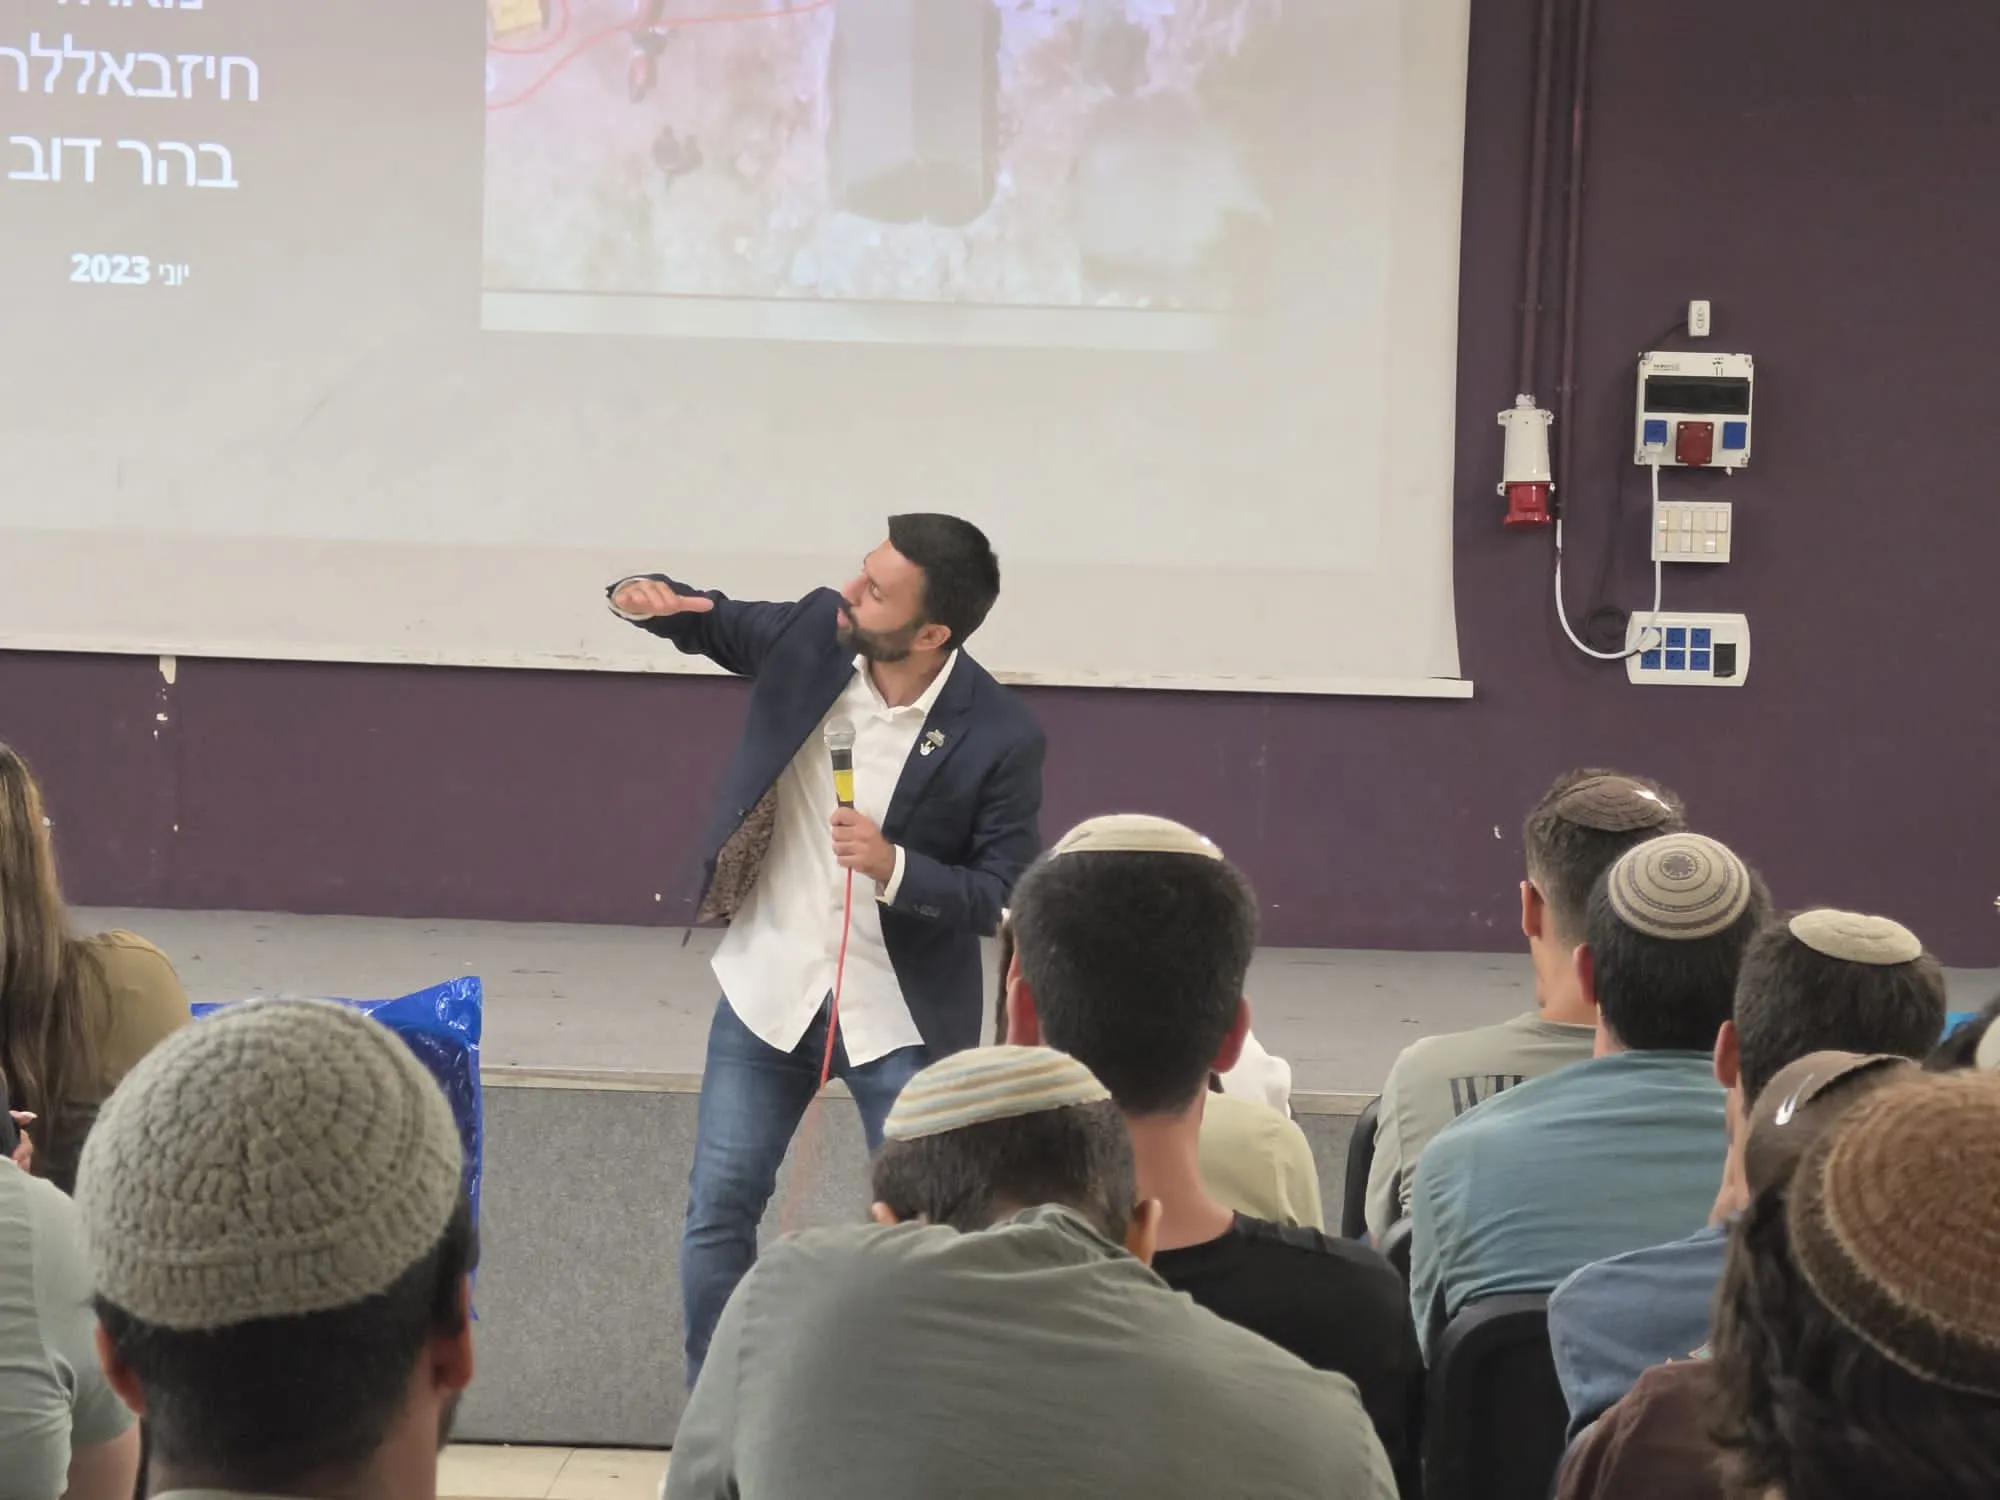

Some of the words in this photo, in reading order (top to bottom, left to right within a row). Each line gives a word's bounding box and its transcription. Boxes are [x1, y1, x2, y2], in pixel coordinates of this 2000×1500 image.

[8, 135, 102, 182] דוב
[117, 139, 239, 188] בהר
[70, 252, 150, 285] 2023
[158, 263, 190, 286] יוני
